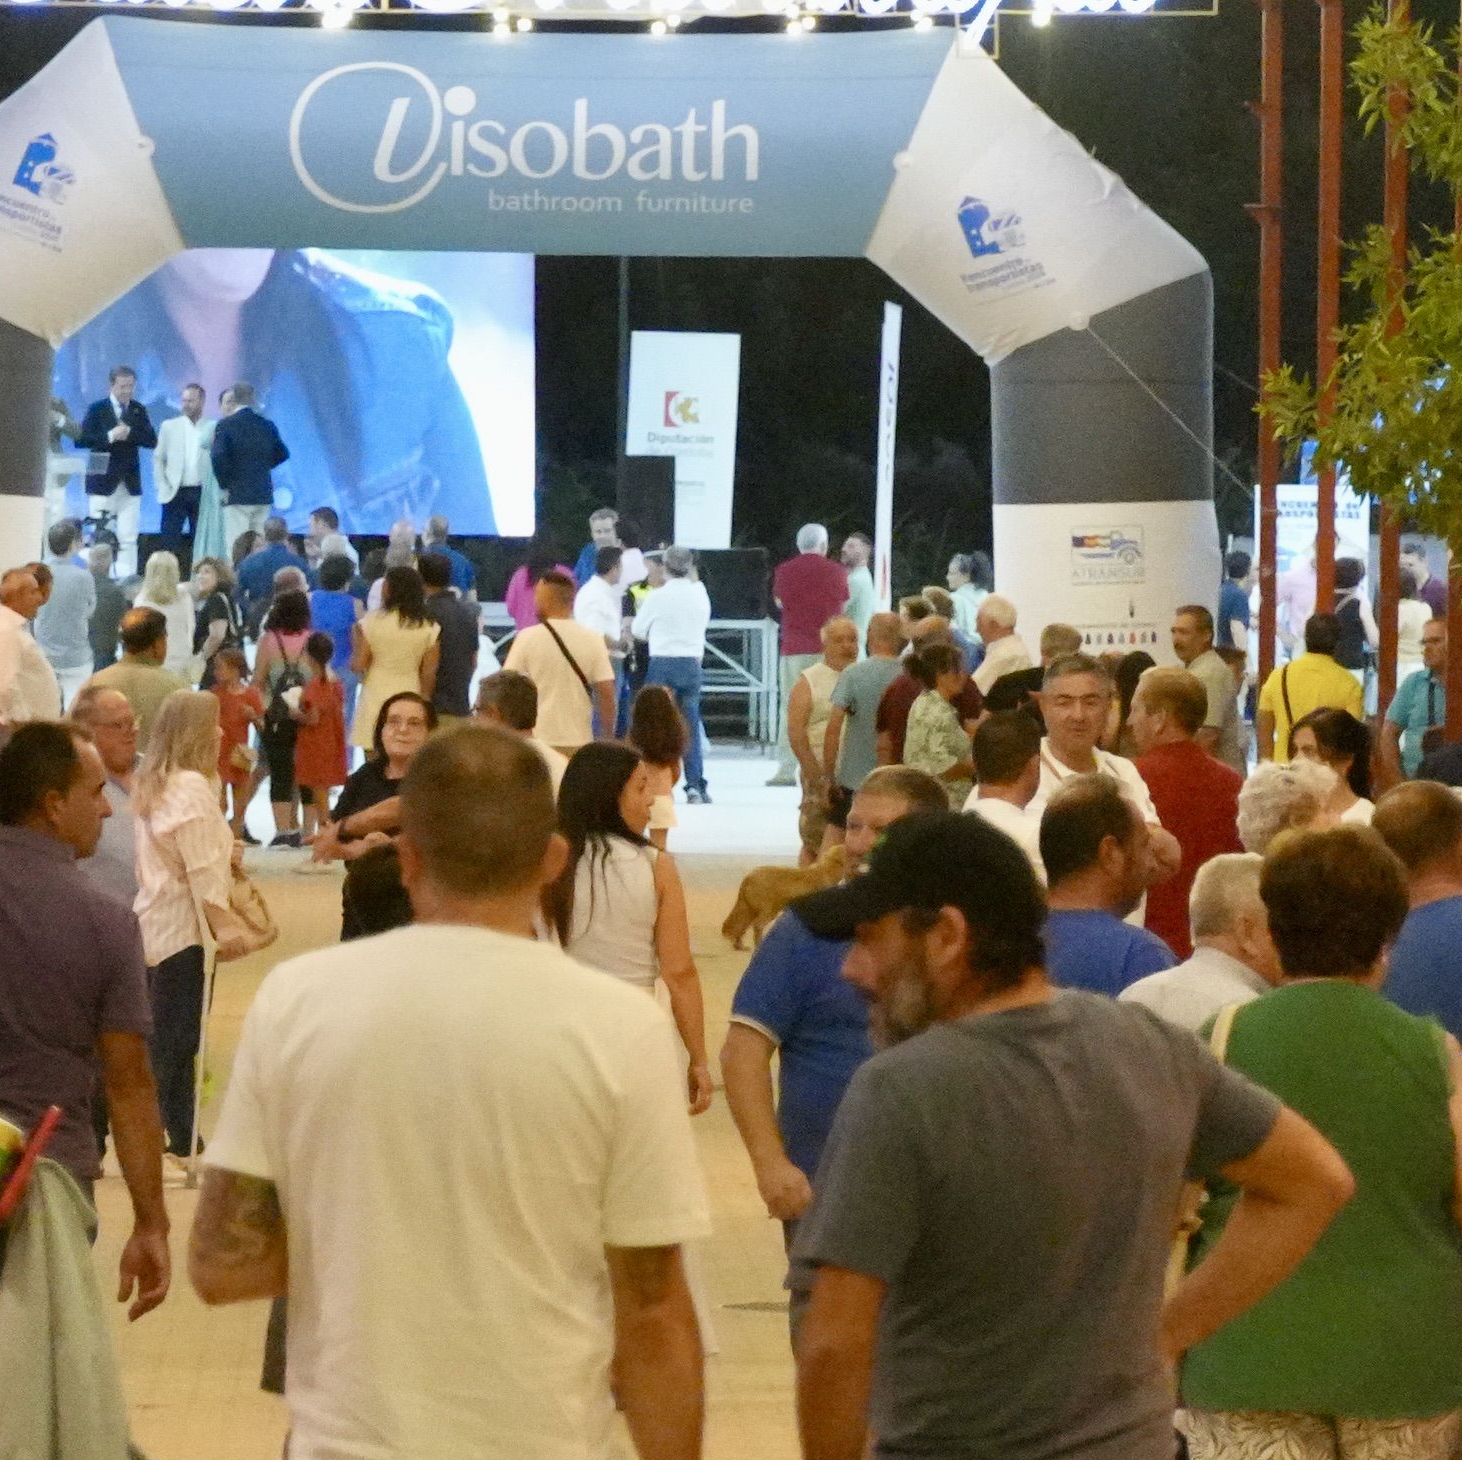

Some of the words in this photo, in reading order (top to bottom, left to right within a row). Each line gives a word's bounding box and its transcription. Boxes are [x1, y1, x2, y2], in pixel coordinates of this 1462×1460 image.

[443, 85, 760, 182] isobath
[487, 187, 623, 213] bathroom
[637, 189, 755, 215] furniture
